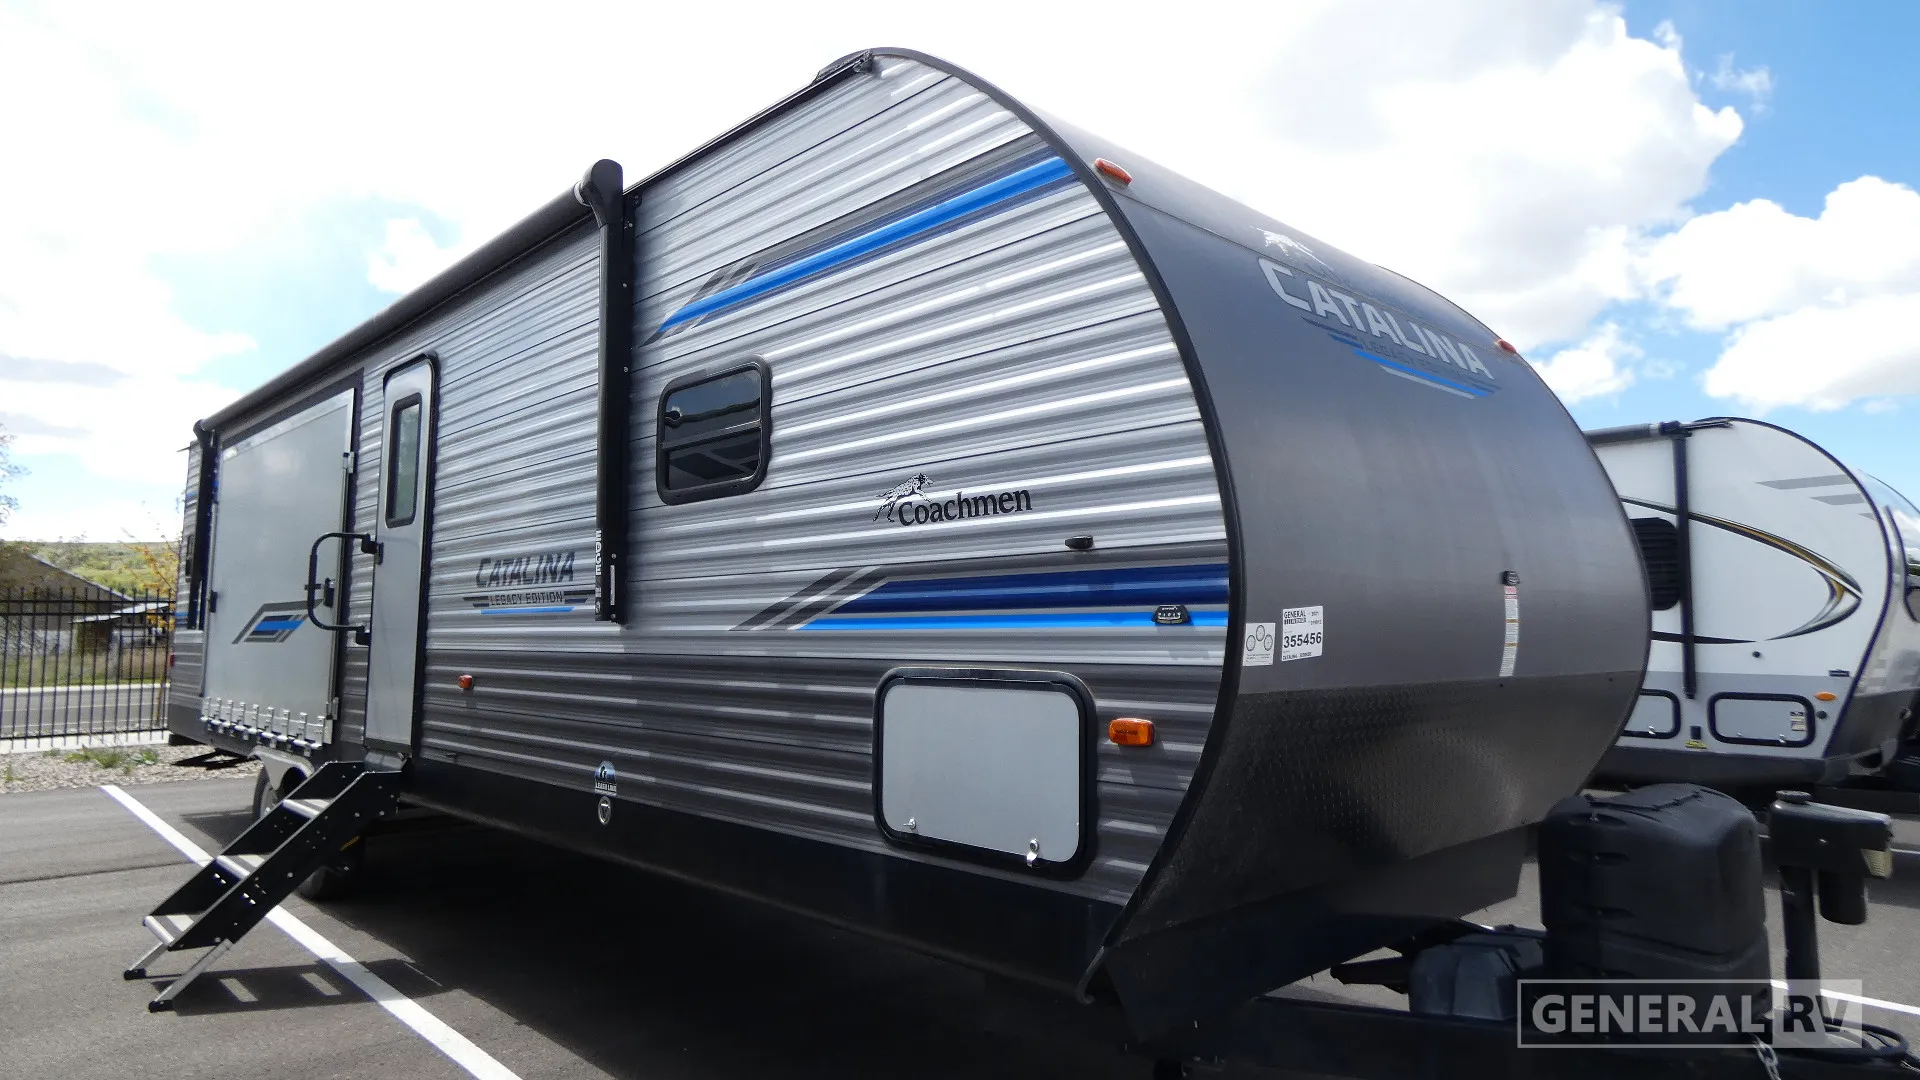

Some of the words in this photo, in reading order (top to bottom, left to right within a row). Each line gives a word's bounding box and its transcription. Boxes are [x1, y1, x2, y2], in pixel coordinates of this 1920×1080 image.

[1257, 257, 1494, 379] CATALINA
[898, 490, 1033, 526] Coachmen
[475, 551, 576, 588] CATALINA
[489, 593, 523, 606] LEGACY
[525, 591, 564, 604] EDITION
[1283, 610, 1306, 619] GENERAL
[1283, 632, 1322, 648] 355456
